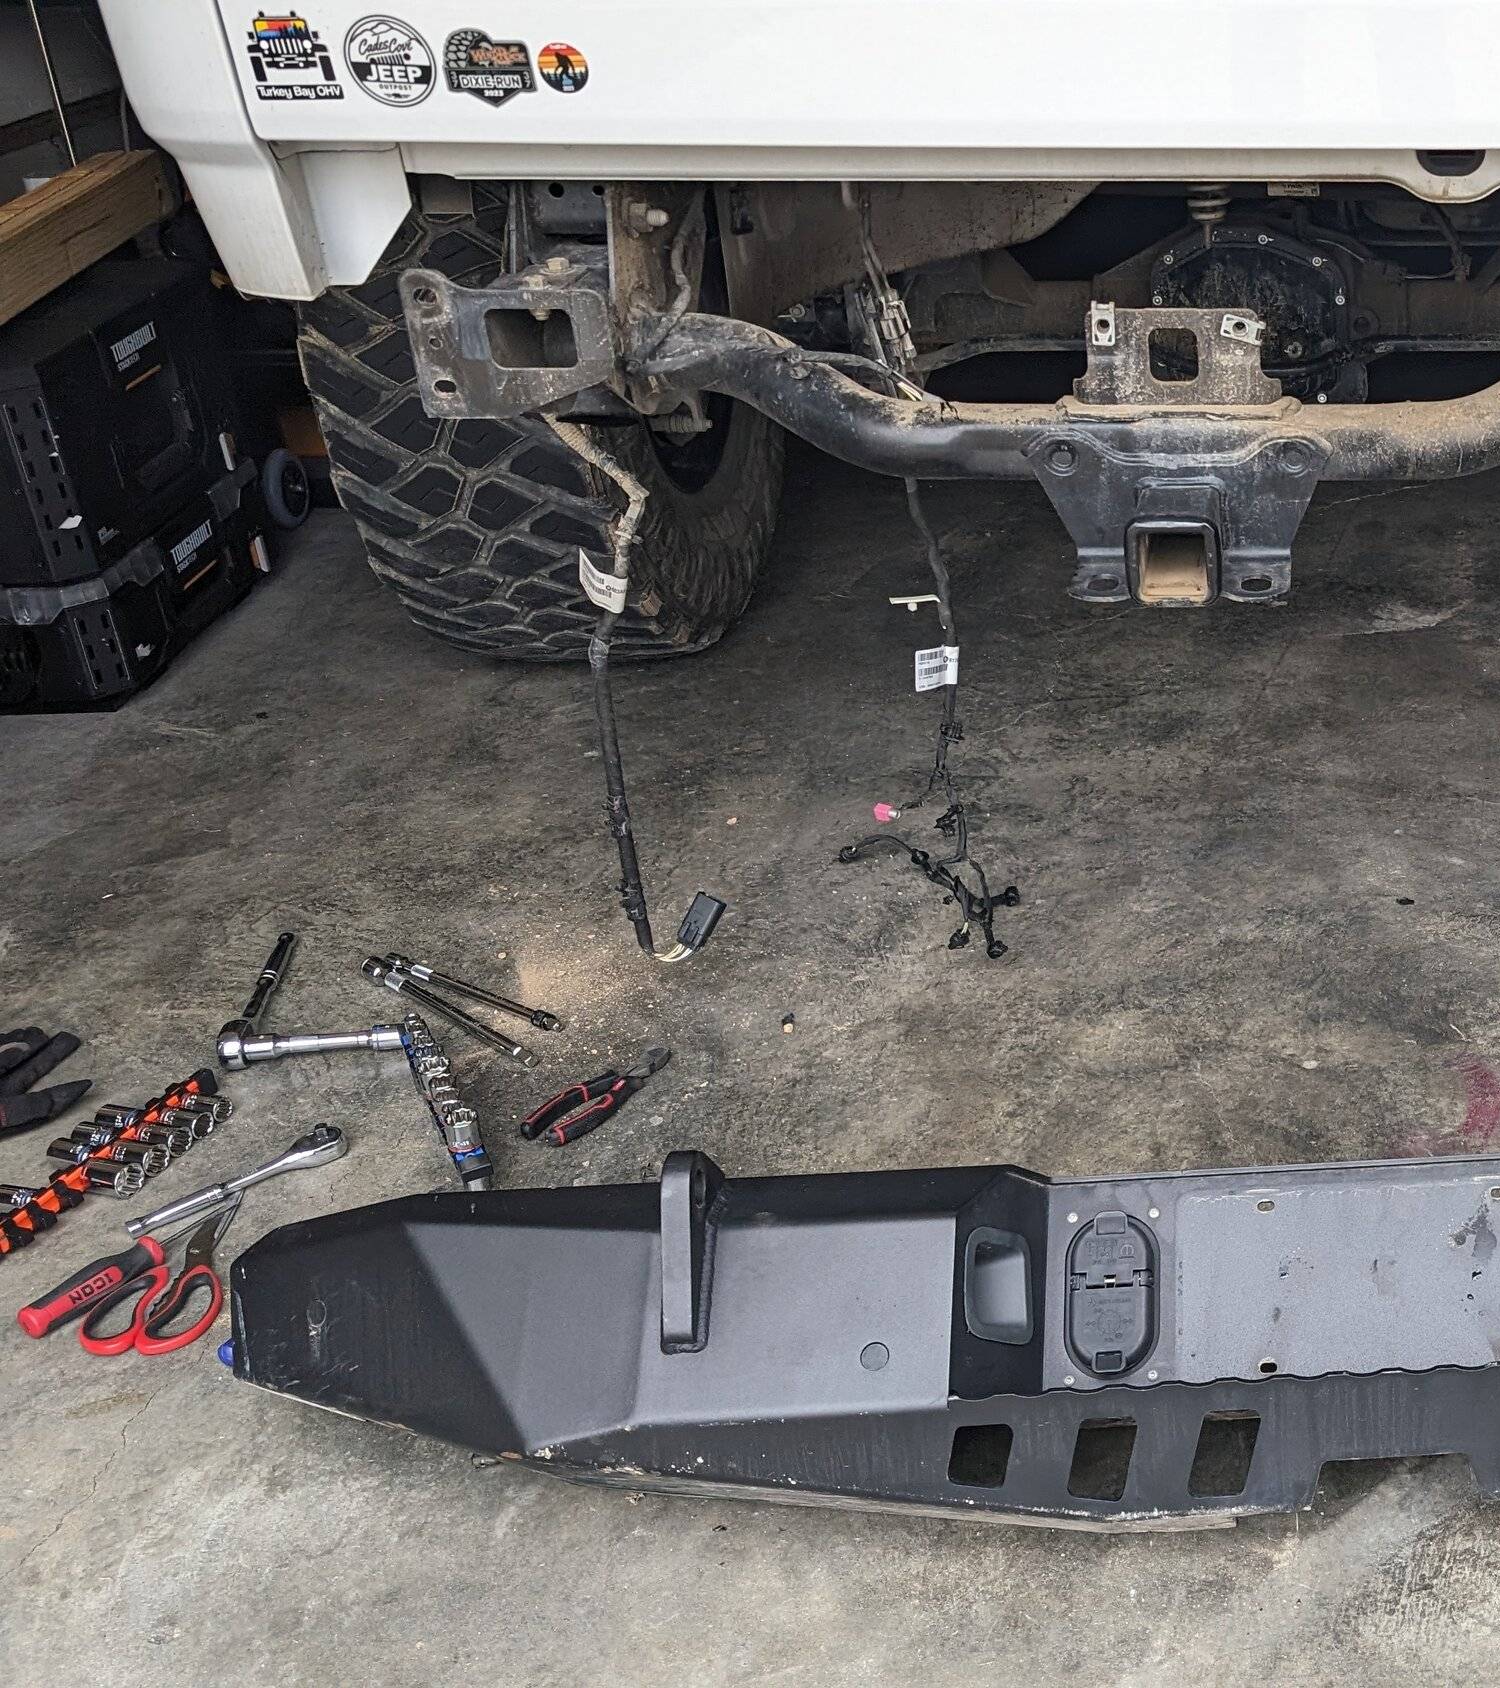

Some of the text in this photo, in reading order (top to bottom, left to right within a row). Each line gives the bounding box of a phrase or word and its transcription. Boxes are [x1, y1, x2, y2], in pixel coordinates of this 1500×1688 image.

[366, 64, 422, 83] JEEP
[257, 85, 341, 99] Turkey Bay OHV
[110, 321, 157, 363] TOUGHBUILT
[170, 519, 213, 565] TOUGHBUILT
[69, 1273, 113, 1304] ICON
